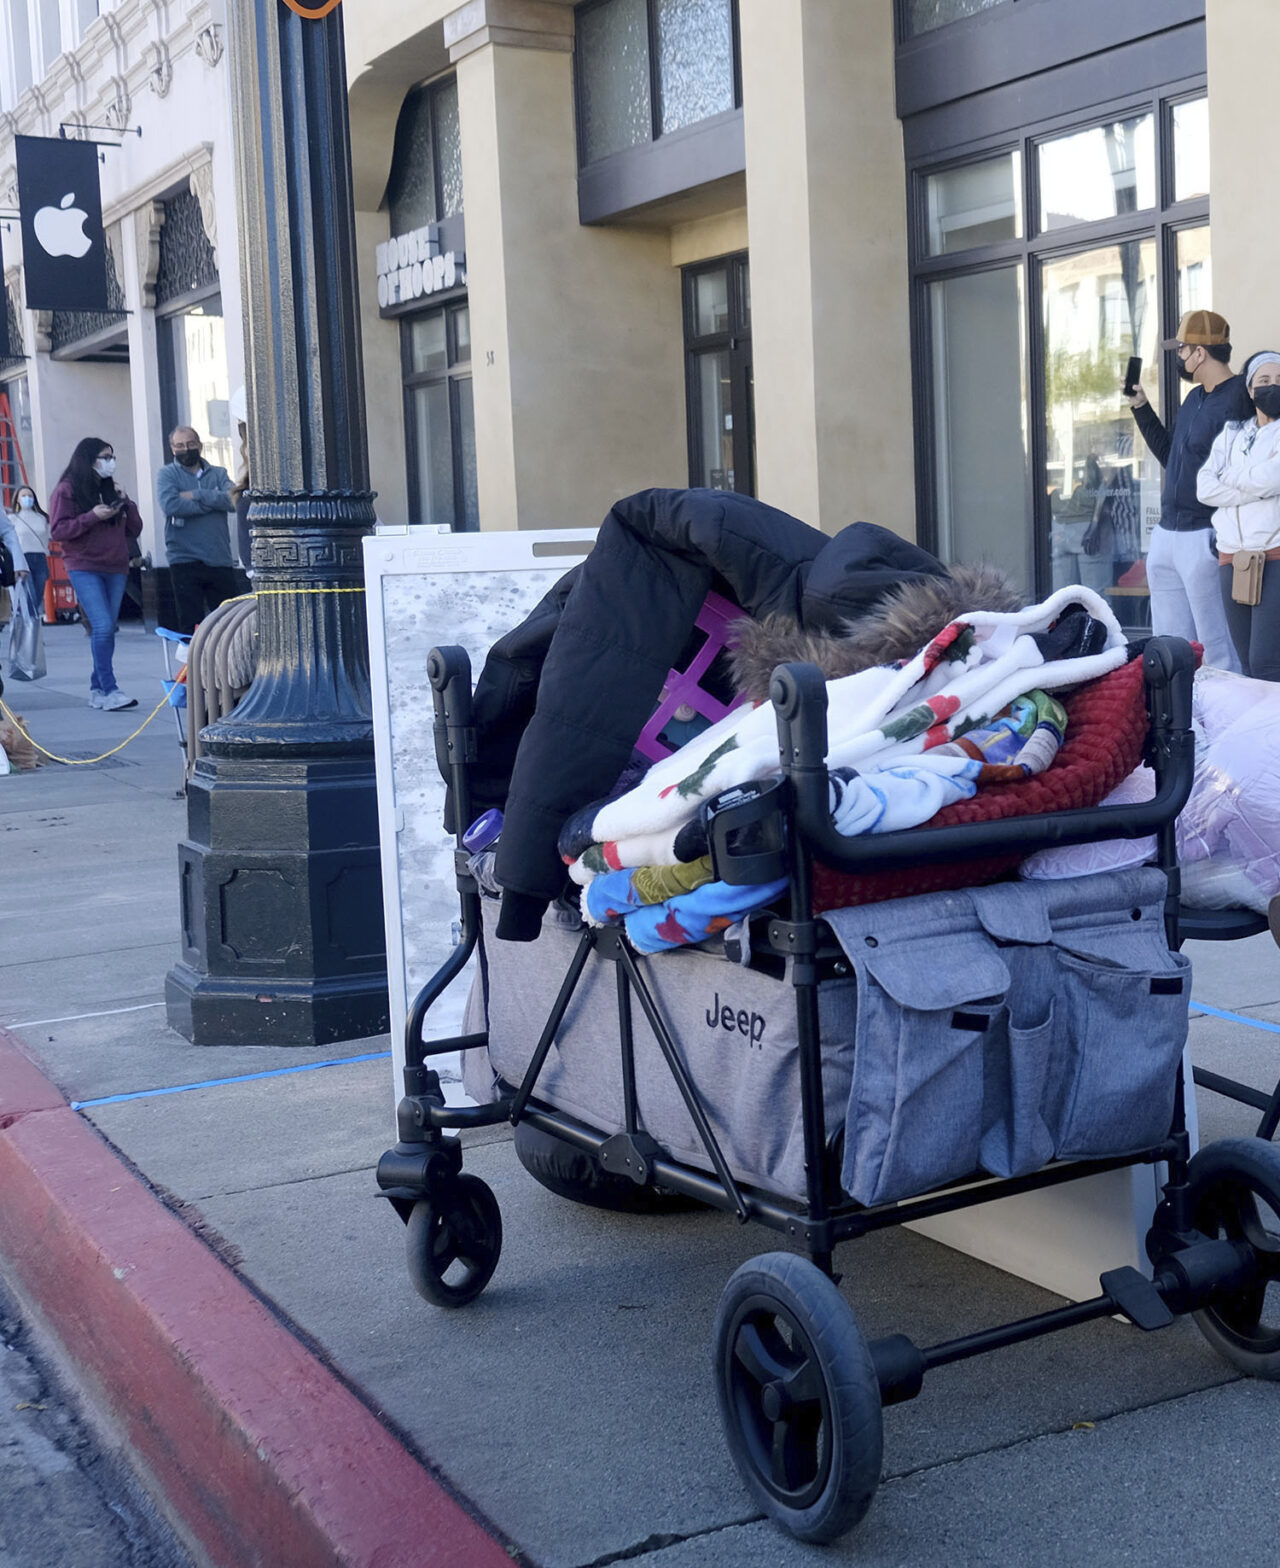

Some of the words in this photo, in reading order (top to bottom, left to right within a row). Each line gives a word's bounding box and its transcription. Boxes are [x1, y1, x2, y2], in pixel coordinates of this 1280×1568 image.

[376, 226, 430, 275] HOUSE
[378, 271, 399, 309] OF
[399, 250, 456, 302] HOOPS
[705, 992, 767, 1049] Jeep
